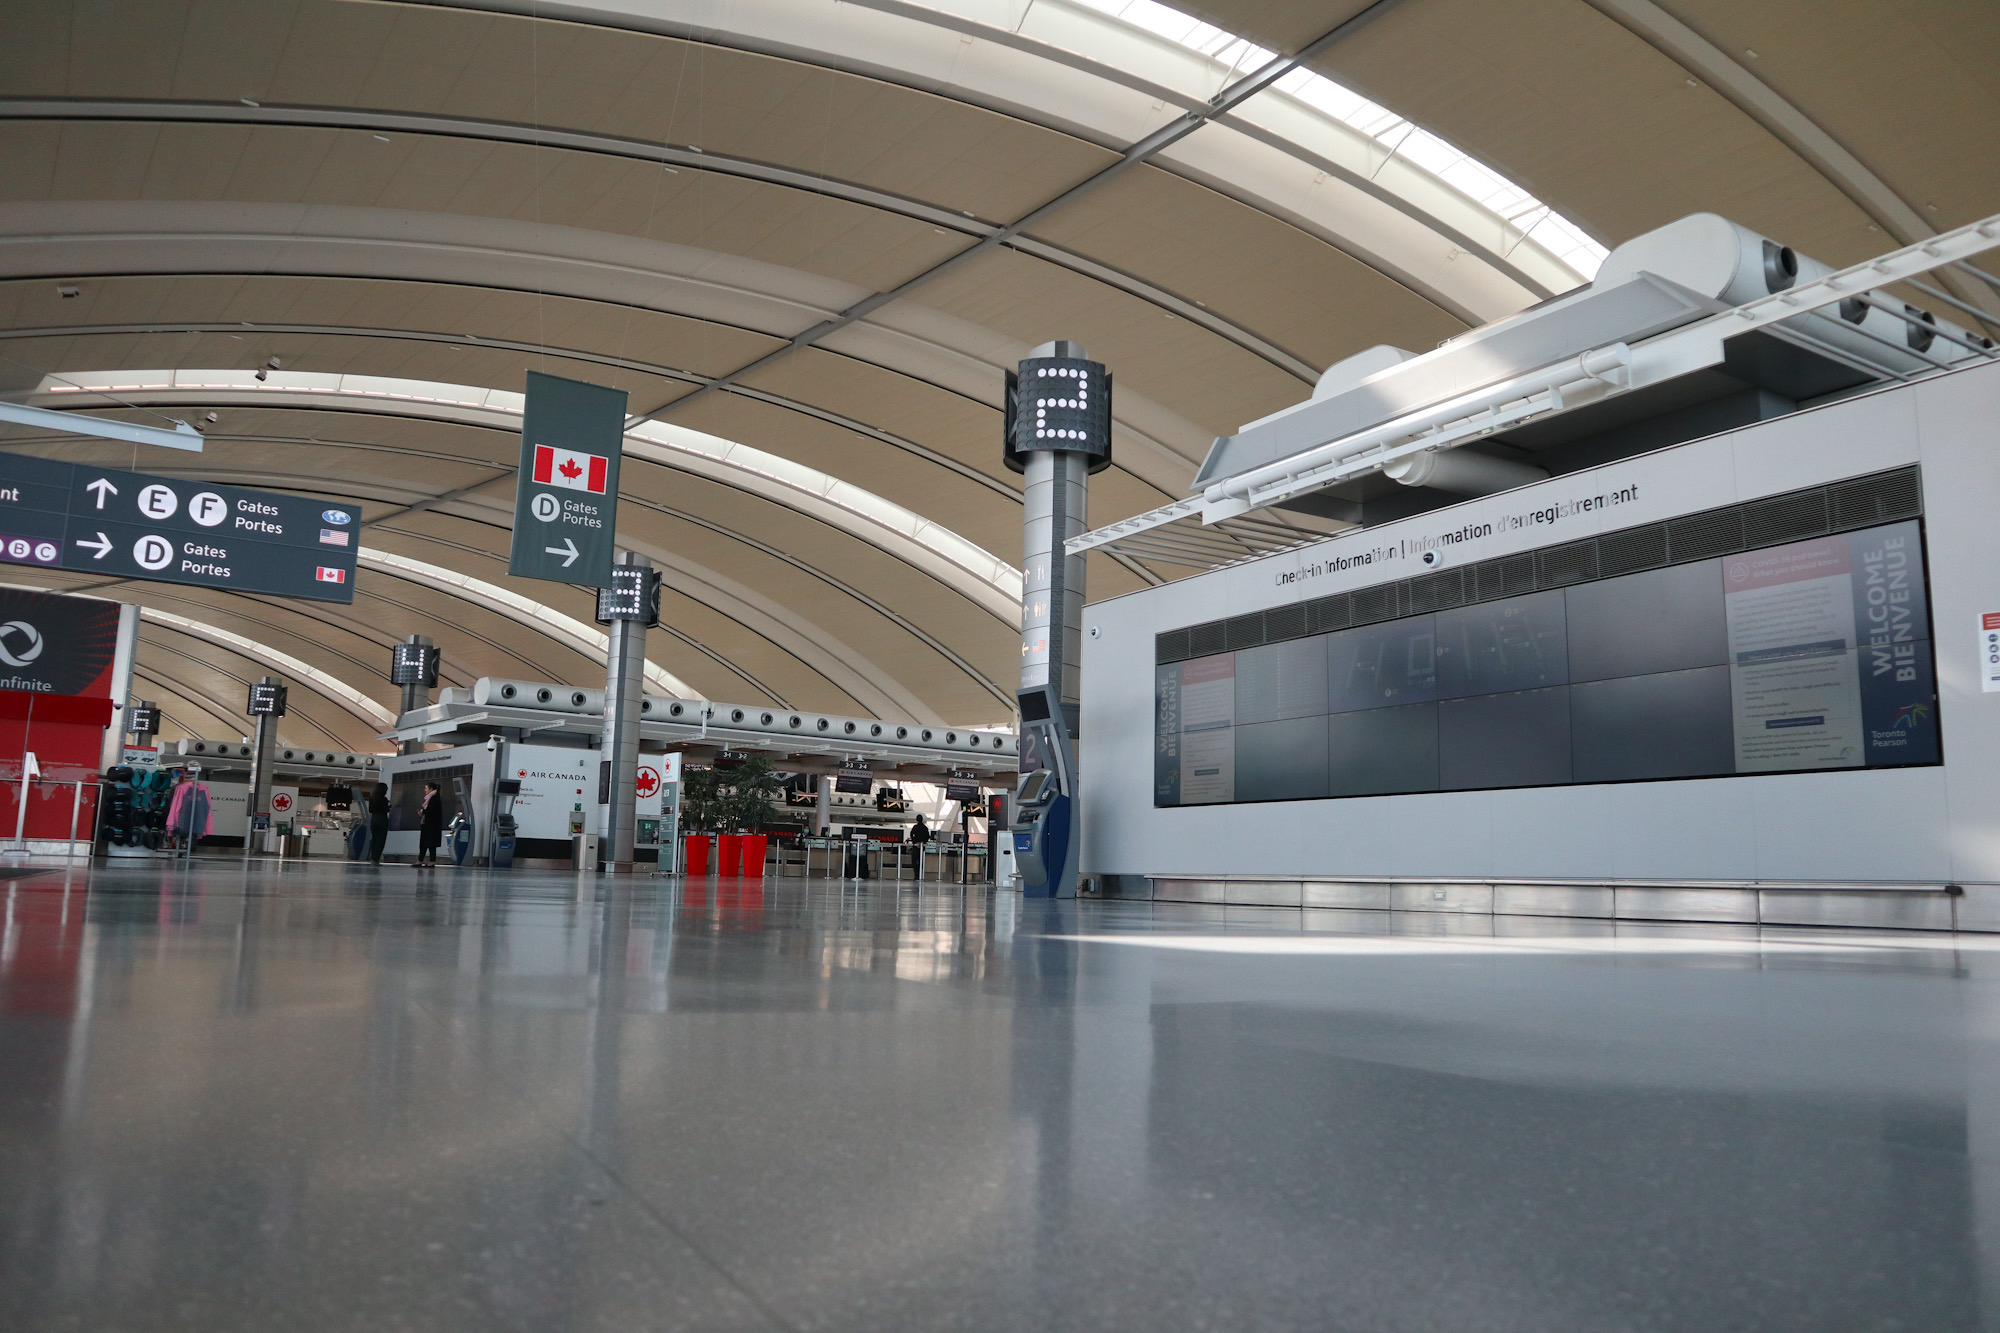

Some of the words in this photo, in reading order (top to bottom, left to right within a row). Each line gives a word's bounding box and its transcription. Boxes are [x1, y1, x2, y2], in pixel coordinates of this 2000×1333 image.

[1036, 368, 1088, 440] 2
[148, 489, 167, 513] E
[199, 497, 218, 519] F
[237, 499, 279, 516] Gates
[538, 497, 555, 517] D
[563, 500, 598, 516] Gates
[235, 516, 283, 535] Portes
[562, 512, 602, 529] Portes
[1275, 564, 1323, 587] Check-in
[1325, 545, 1398, 574] Information
[1410, 520, 1492, 552] Information
[1497, 483, 1639, 533] d'enregistrement
[13, 542, 25, 555] B
[40, 546, 52, 558] C
[143, 540, 166, 563] D
[183, 542, 227, 559] Gates
[181, 559, 231, 577] Portes
[609, 570, 642, 614] 3
[1864, 549, 1893, 677] WELCOME
[1885, 535, 1917, 682] BIENVENUE
[401, 647, 425, 680] 4
[0, 675, 52, 692] nfinite
[255, 687, 275, 711] 5
[132, 708, 151, 731] 6
[1160, 677, 1169, 753] WELCOME
[1168, 670, 1177, 757] BIENVENUE
[1872, 729, 1906, 739] Toronto
[1872, 738, 1907, 747] Pearson
[530, 771, 546, 779] AIR
[548, 772, 587, 781] CANADA
